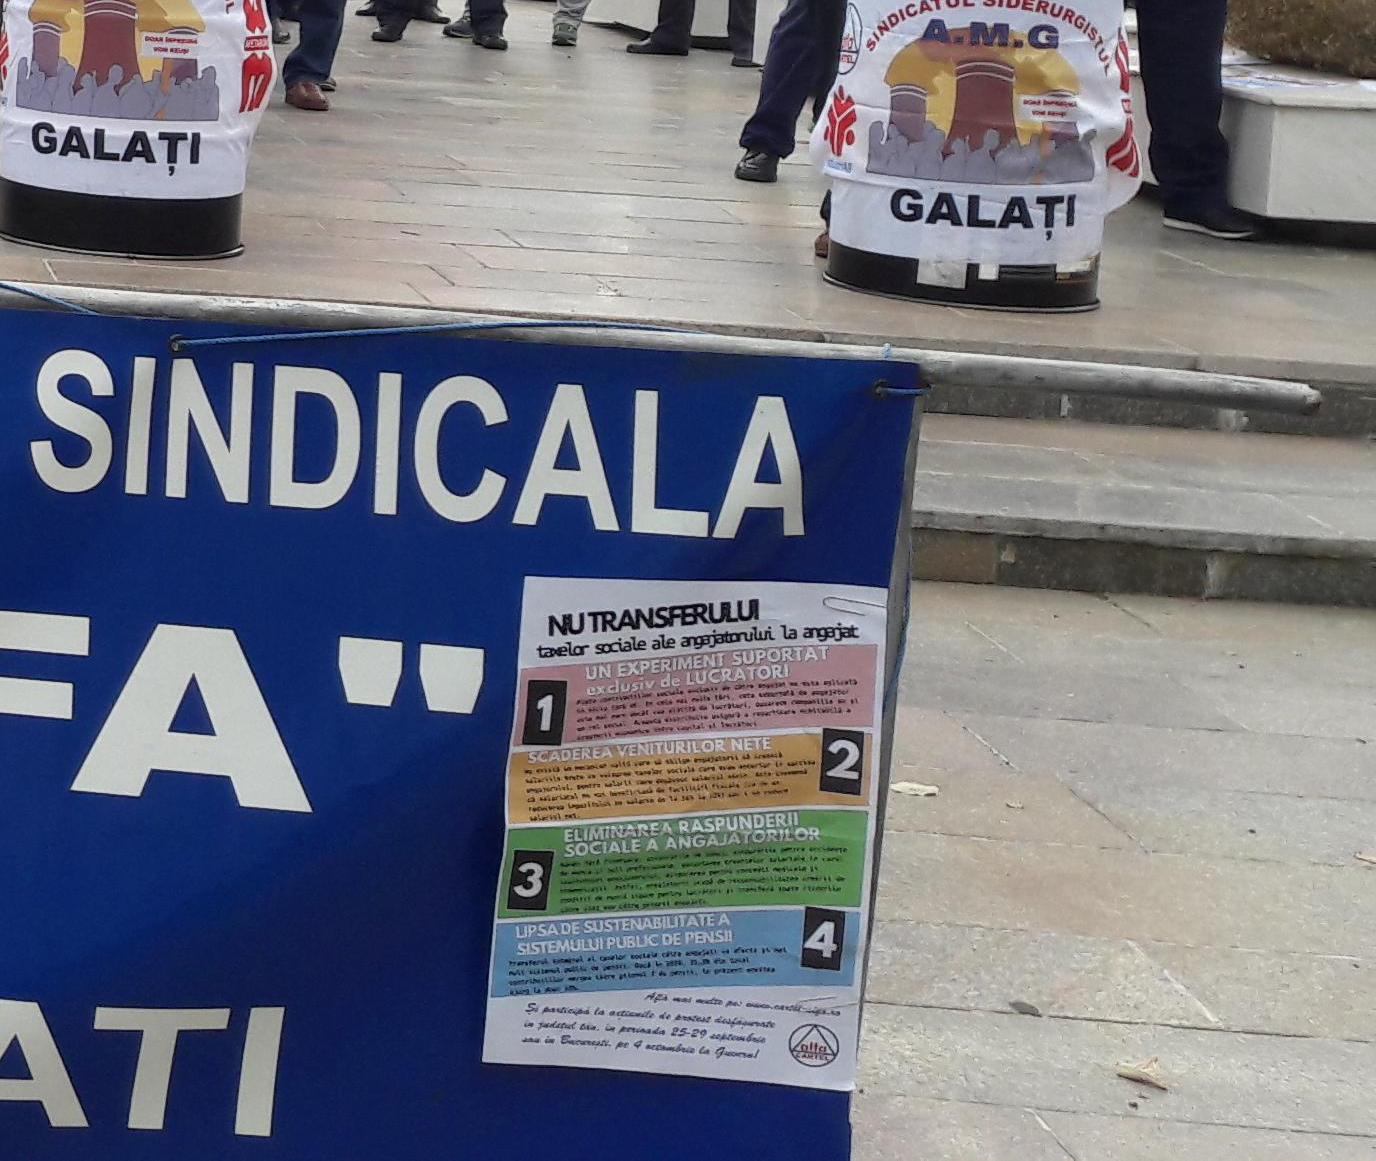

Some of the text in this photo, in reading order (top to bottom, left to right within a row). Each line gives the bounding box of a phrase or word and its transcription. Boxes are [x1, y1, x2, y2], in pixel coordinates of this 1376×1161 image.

[922, 18, 1059, 49] A.M.G
[31, 122, 201, 176] GALAȚI
[890, 188, 1077, 241] GALAȚI
[31, 349, 808, 539] SINDICALA
[548, 597, 759, 636] NU TRANSFERULUI
[536, 622, 859, 658] taxelor sociale ale angajatorului la angajat
[586, 645, 830, 680] UN EXPERIMENT SUPORTAT
[587, 678, 655, 696] exclusiv
[661, 673, 680, 688] de
[537, 694, 554, 732] 1
[528, 737, 772, 764] SCADEREA VENITURILOR NETE
[825, 740, 860, 780] 2
[564, 812, 798, 843] ELIMINAREA RASPUNDERII
[564, 827, 821, 858] SOCIALE A ANGAJATORILOR
[513, 862, 544, 898] 3
[515, 913, 730, 939] LIPSA DE SUSTENABILITATE A
[517, 929, 733, 956] SISTEMULUI PUBLIC DE PENSII
[805, 921, 839, 958] 4
[670, 1027, 708, 1039] 25-29
